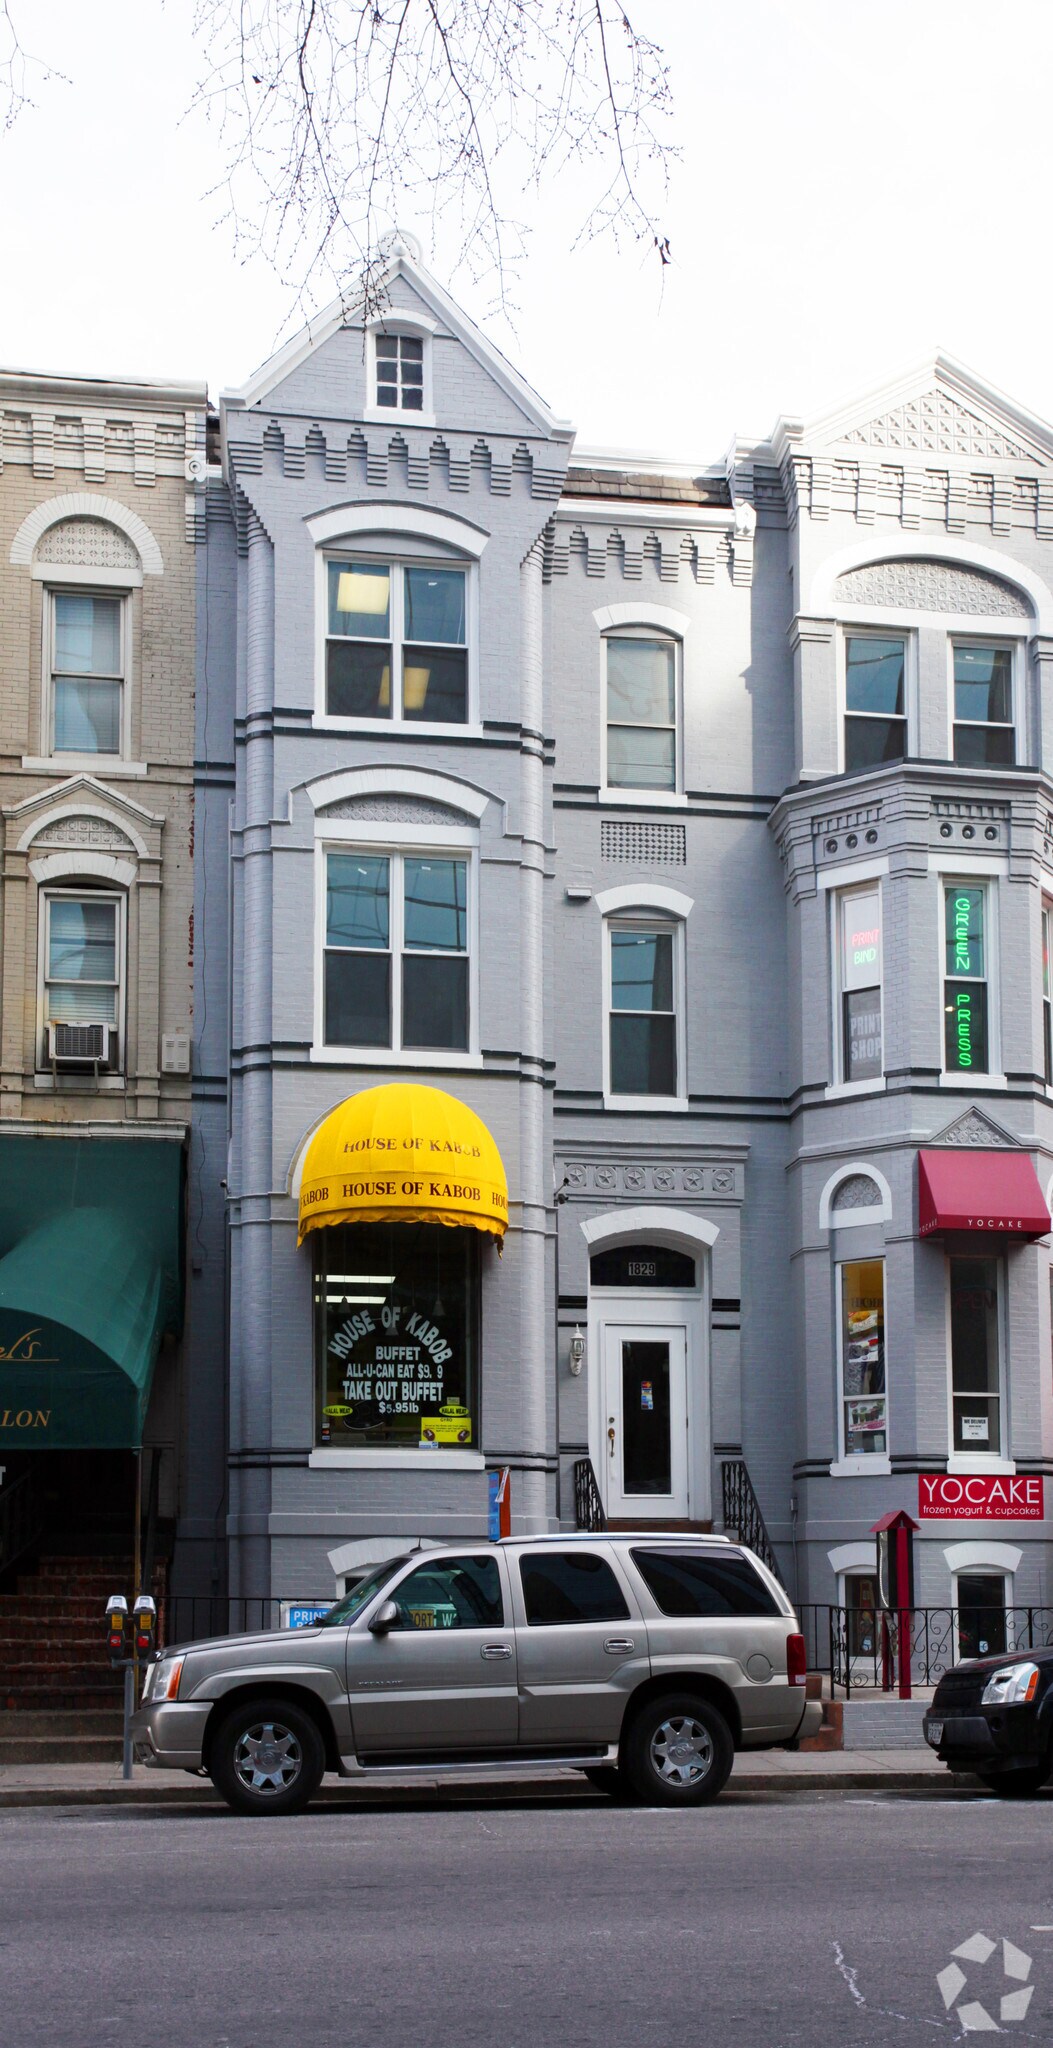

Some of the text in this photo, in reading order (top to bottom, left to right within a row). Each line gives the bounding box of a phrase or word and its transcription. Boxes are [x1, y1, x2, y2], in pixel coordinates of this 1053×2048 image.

[852, 929, 879, 945] PRINT
[854, 949, 876, 964] BIND
[955, 898, 972, 1066] GREEN PRESS
[851, 1012, 881, 1037] PRINT
[851, 1036, 882, 1060] SHOP
[344, 1138, 481, 1157] HOUSE OF KABOB
[343, 1182, 481, 1201] HOUSE OF KABOB
[968, 1219, 1022, 1228] YOCAKE
[630, 1263, 654, 1275] 1829
[328, 1306, 453, 1364] HOUSE OF KABOB
[375, 1346, 420, 1361] BUFFET
[347, 1364, 394, 1378] ALL-U-CAN
[398, 1365, 414, 1378] EAT
[343, 1381, 443, 1401] TAKE OUT BUFFET
[923, 1479, 1040, 1504] YOCAKE
[923, 1506, 1040, 1517] frozen yogurt & cupcakes
